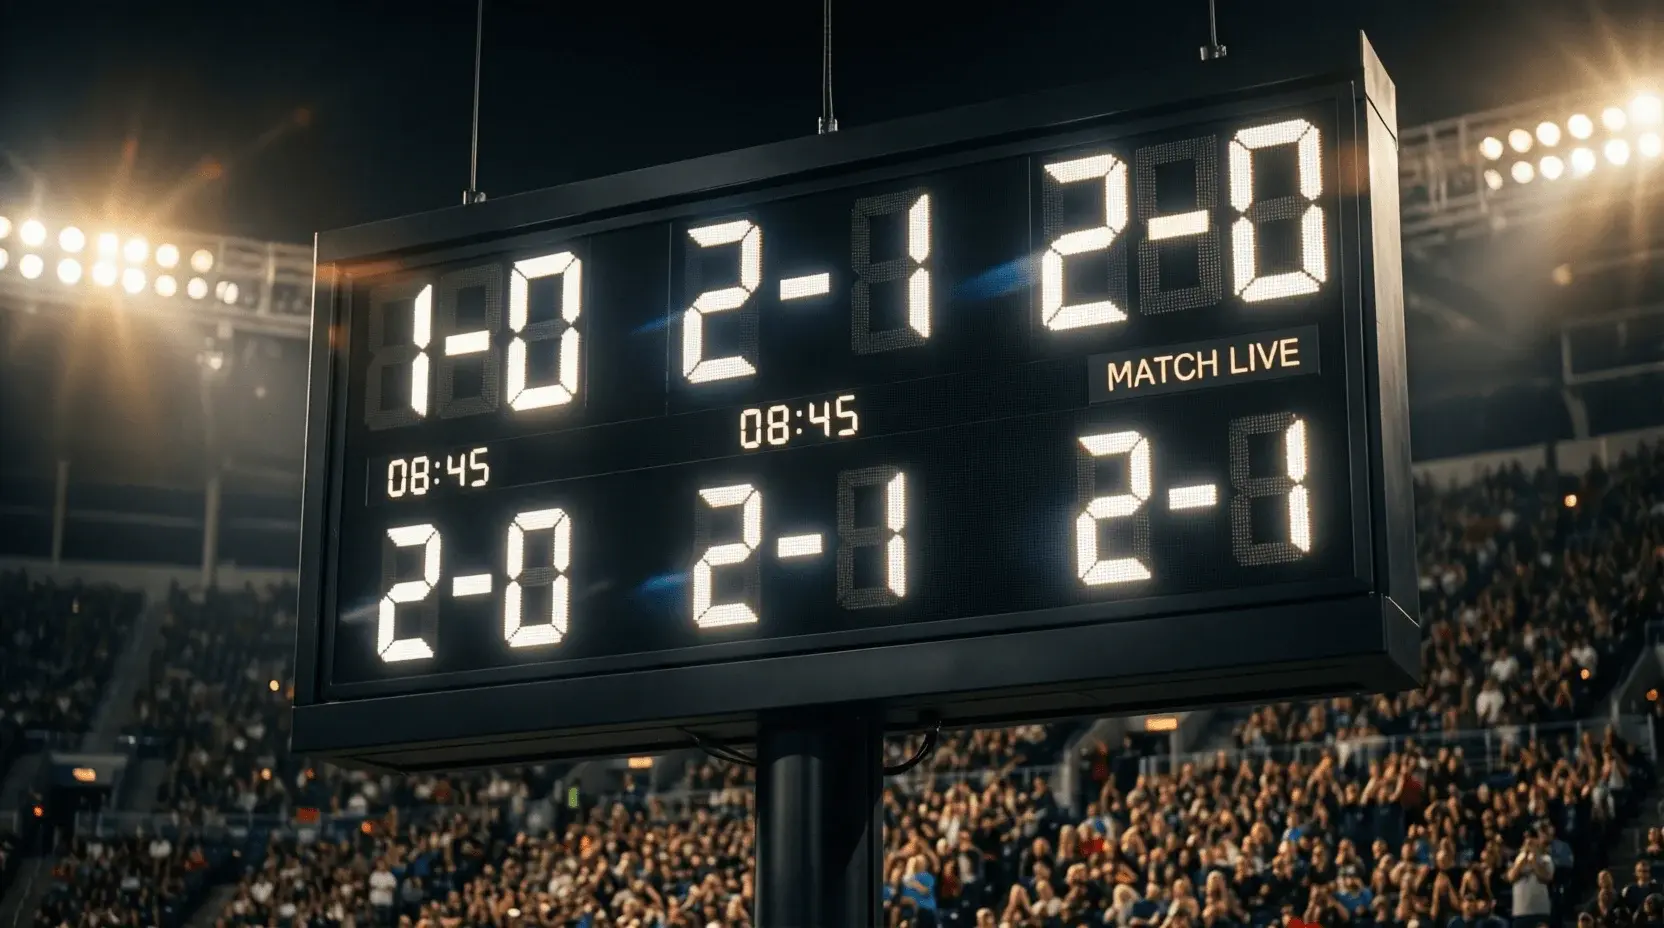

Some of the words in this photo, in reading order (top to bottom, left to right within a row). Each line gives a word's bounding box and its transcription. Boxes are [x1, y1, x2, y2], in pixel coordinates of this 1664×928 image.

[1107, 348, 1219, 392] MATCH
[1229, 337, 1301, 376] LIVE
[740, 394, 858, 448] 08:45
[387, 447, 489, 498] 08:45
